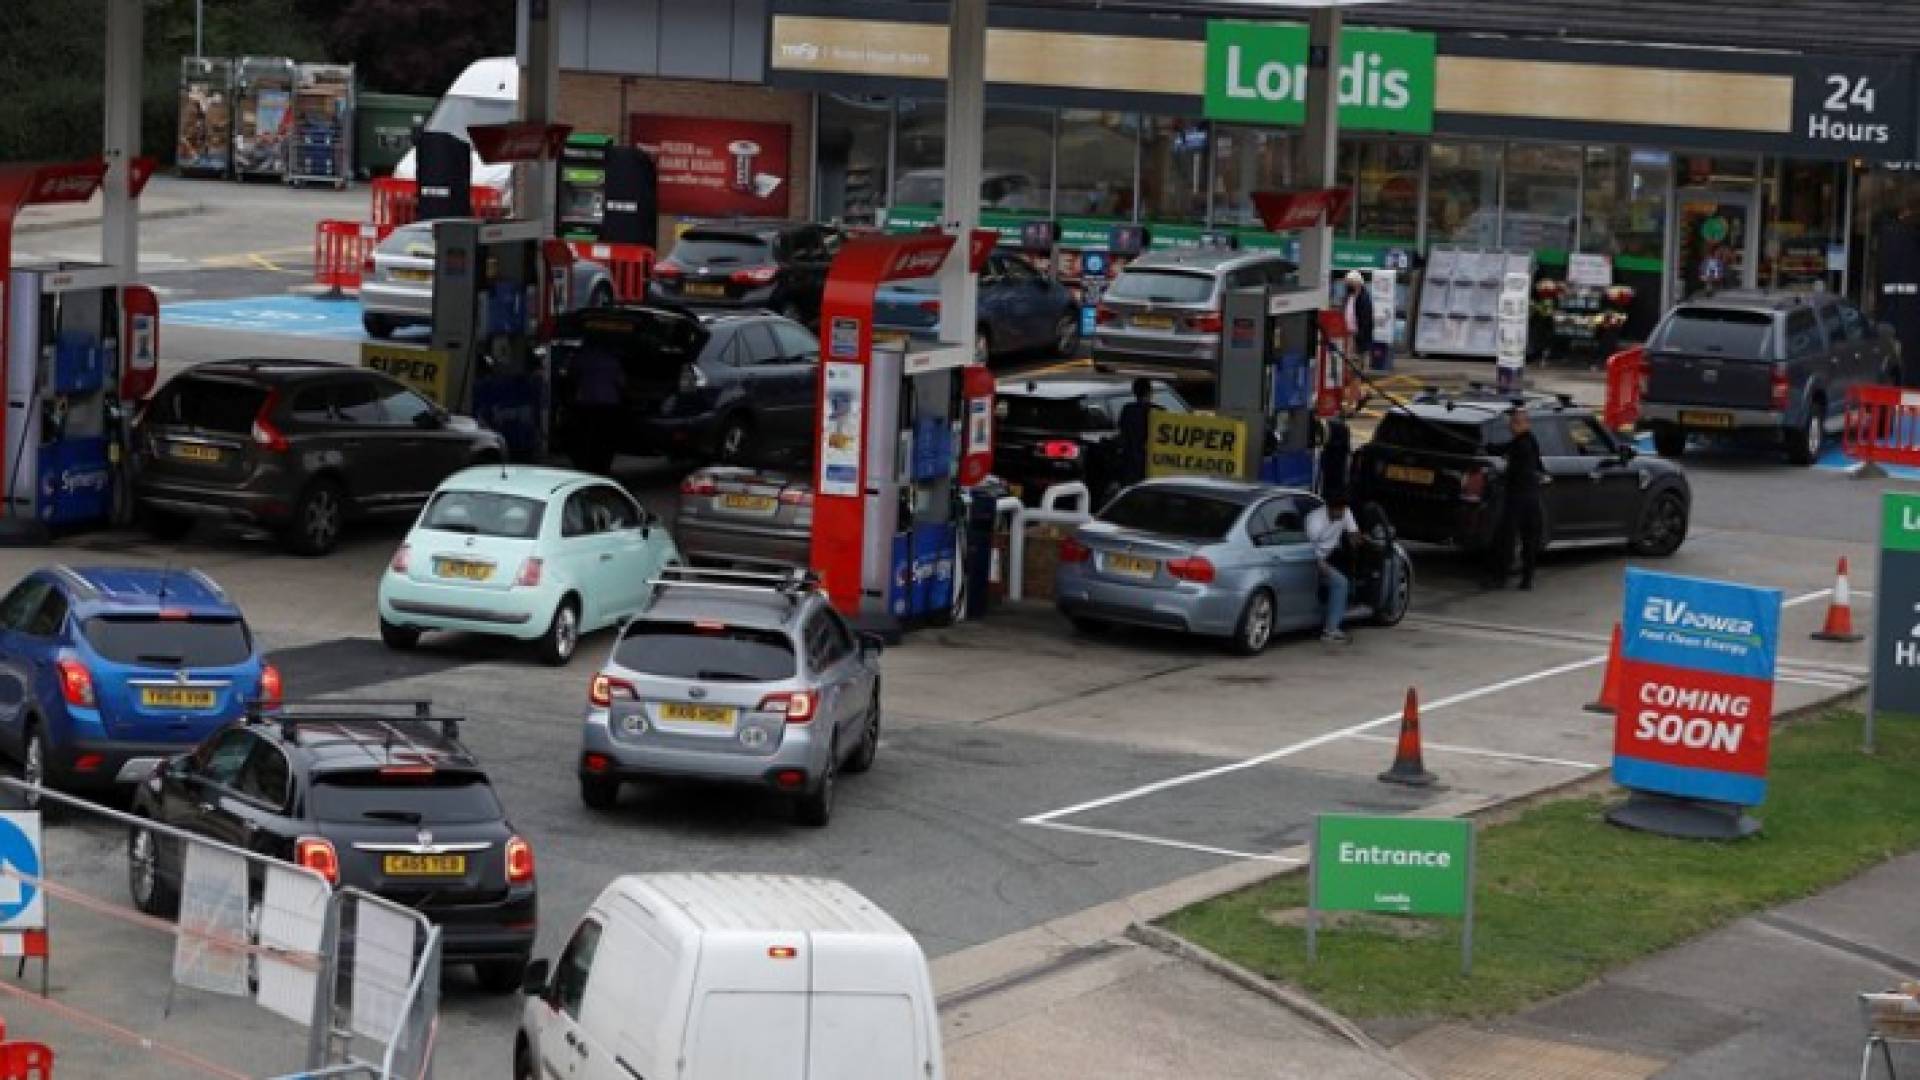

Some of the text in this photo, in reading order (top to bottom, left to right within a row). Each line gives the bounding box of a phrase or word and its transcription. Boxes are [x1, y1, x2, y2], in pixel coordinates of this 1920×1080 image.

[1822, 73, 1875, 113] 24
[1808, 112, 1890, 143] Hours
[367, 354, 439, 383] SUPER
[1154, 422, 1236, 453] SUPER
[1639, 680, 1753, 719] COMING
[1633, 710, 1745, 754] SOON
[1340, 841, 1451, 868] Entrance
